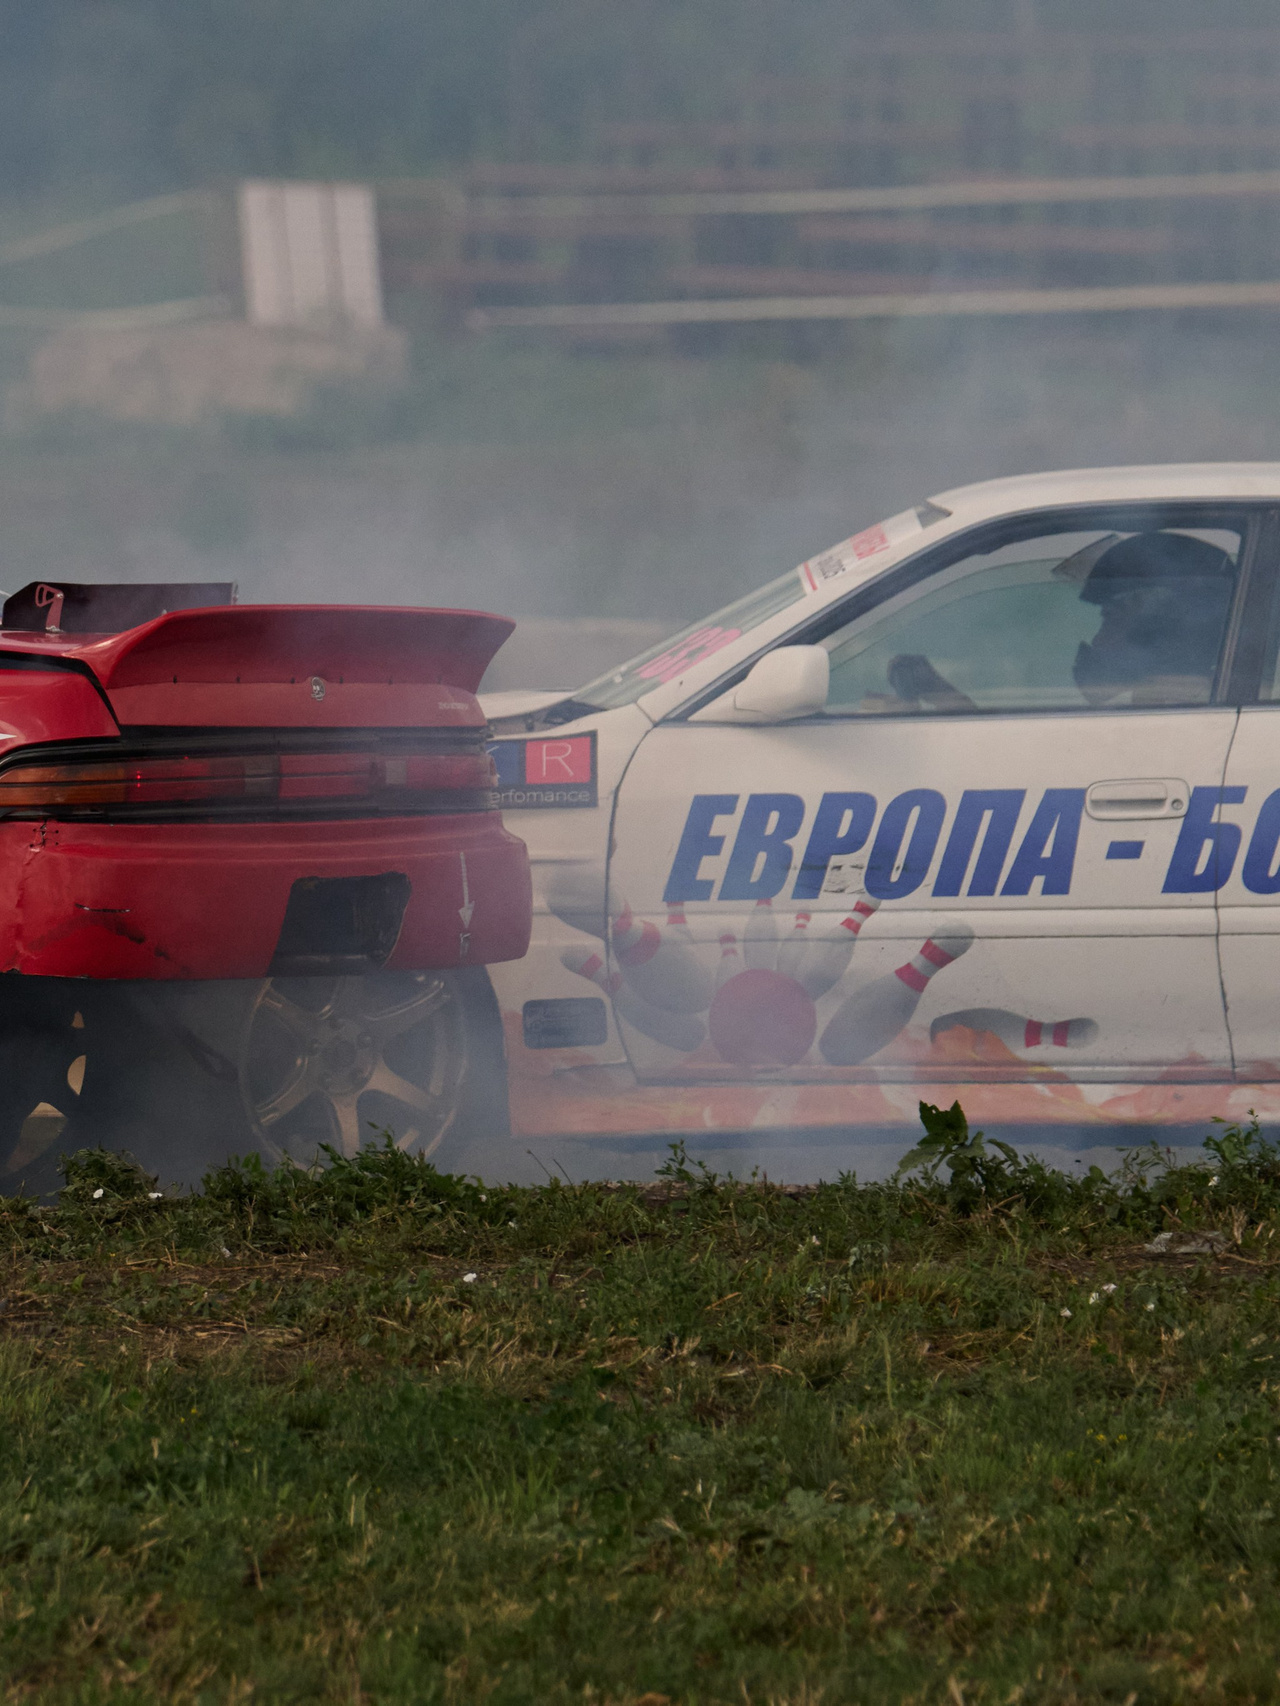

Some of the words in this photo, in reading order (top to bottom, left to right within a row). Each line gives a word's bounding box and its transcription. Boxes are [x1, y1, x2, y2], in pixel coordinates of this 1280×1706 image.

[542, 742, 574, 777] R
[490, 789, 591, 803] erfomance
[662, 787, 1088, 902] ЕВРОПА
